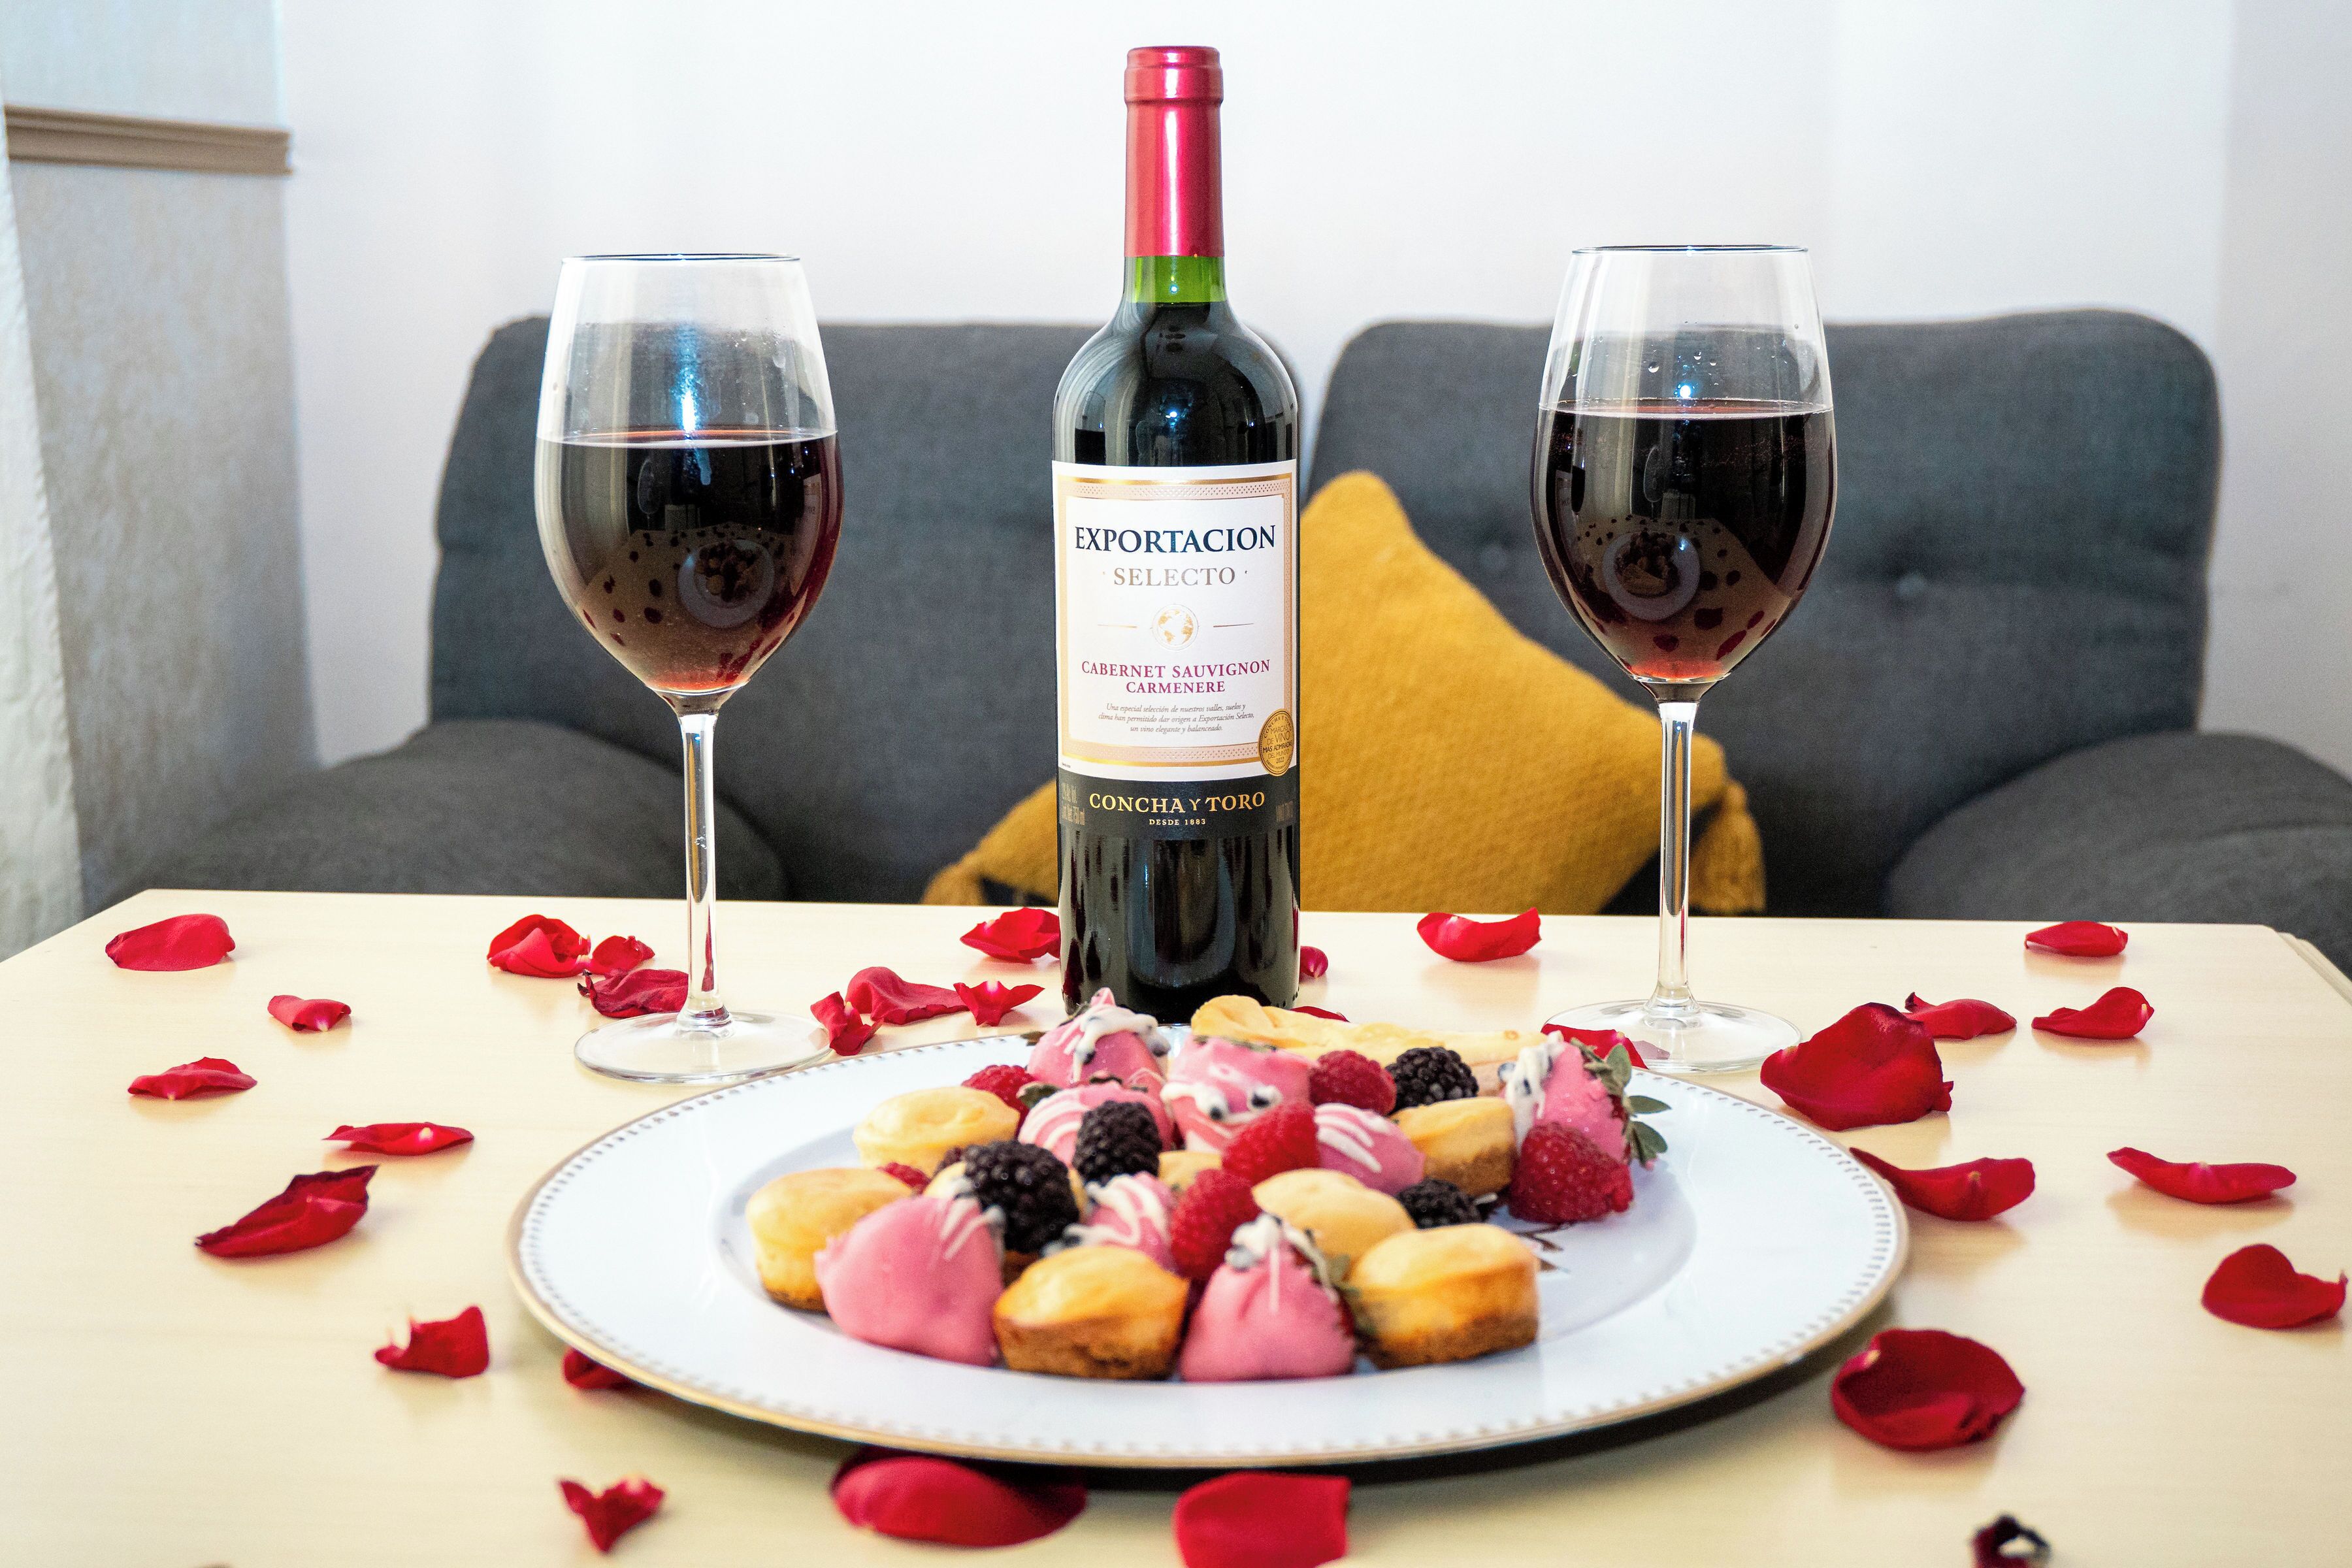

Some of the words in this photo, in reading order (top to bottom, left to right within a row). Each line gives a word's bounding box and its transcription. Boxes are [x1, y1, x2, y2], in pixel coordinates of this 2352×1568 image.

[1075, 525, 1275, 553] EXPORTACION
[1114, 566, 1235, 586] SELECTO
[1082, 661, 1166, 678] CABERNET
[1172, 659, 1270, 678] SAUVIGNON
[1126, 681, 1226, 693] CARMENERE
[1120, 704, 1142, 713] especial
[1126, 715, 1157, 723] permitido
[1171, 715, 1190, 725] origen
[1198, 713, 1234, 724] Exportación
[1235, 711, 1254, 720] Selecto,
[1155, 725, 1181, 734] elegante
[1187, 723, 1222, 732] balanceado.
[1264, 716, 1281, 738] CONCHA
[1270, 725, 1288, 734] MARCAS
[1275, 730, 1290, 743] VINO
[1089, 793, 1186, 813] CONCHA
[1188, 798, 1201, 811] Y
[1205, 792, 1265, 811] TORO
